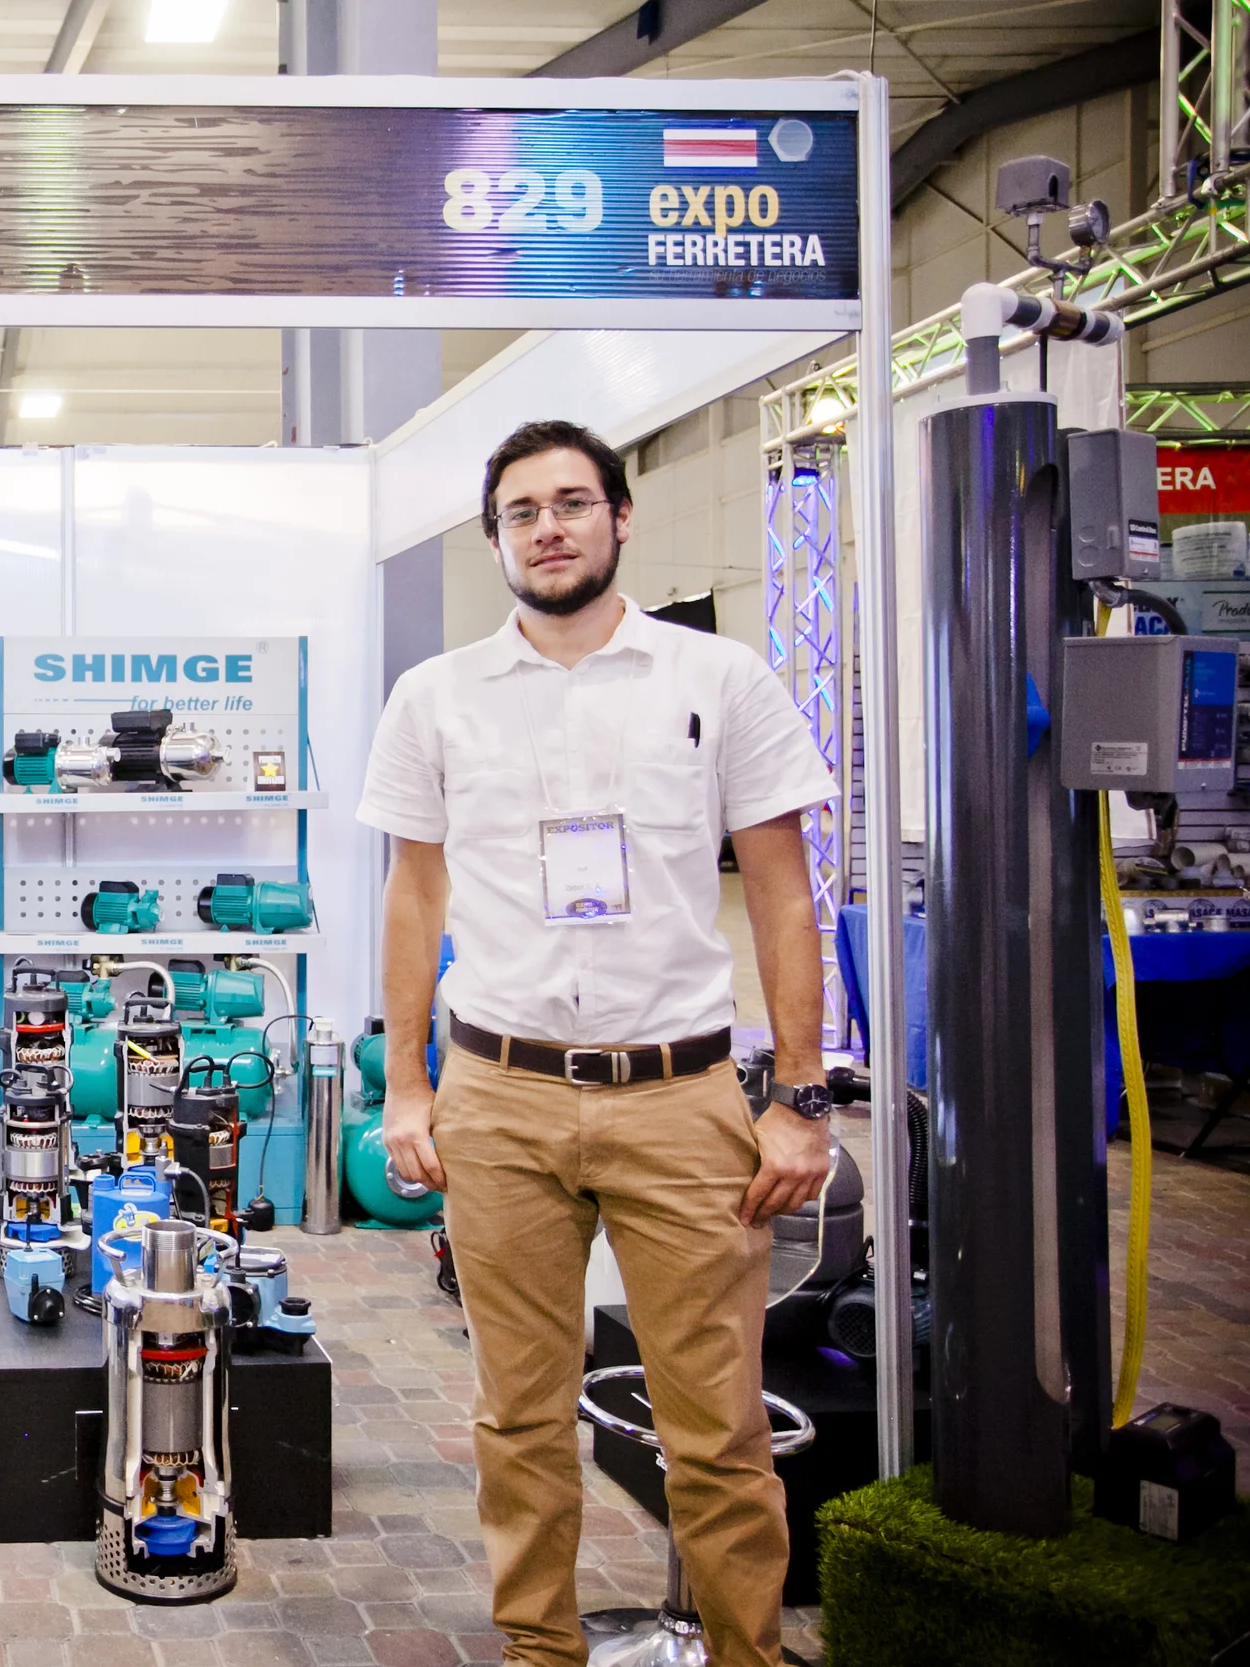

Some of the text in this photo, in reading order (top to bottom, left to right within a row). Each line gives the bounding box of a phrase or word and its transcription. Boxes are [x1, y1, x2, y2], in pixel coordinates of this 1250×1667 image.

[442, 168, 603, 233] 829
[649, 184, 780, 239] expo
[647, 234, 827, 267] FERRETERA
[768, 270, 827, 286] negocios
[33, 653, 253, 684] SHIMGE
[130, 695, 254, 712] for better life
[35, 797, 79, 805] SHIMGE
[140, 795, 184, 803] SHIMGE
[245, 794, 289, 802] SHIMGE
[546, 822, 616, 835] EXPOSITOR
[36, 939, 80, 947] SHIMGE
[141, 938, 184, 946] SHIMGE
[245, 938, 288, 946] SHIMGE
